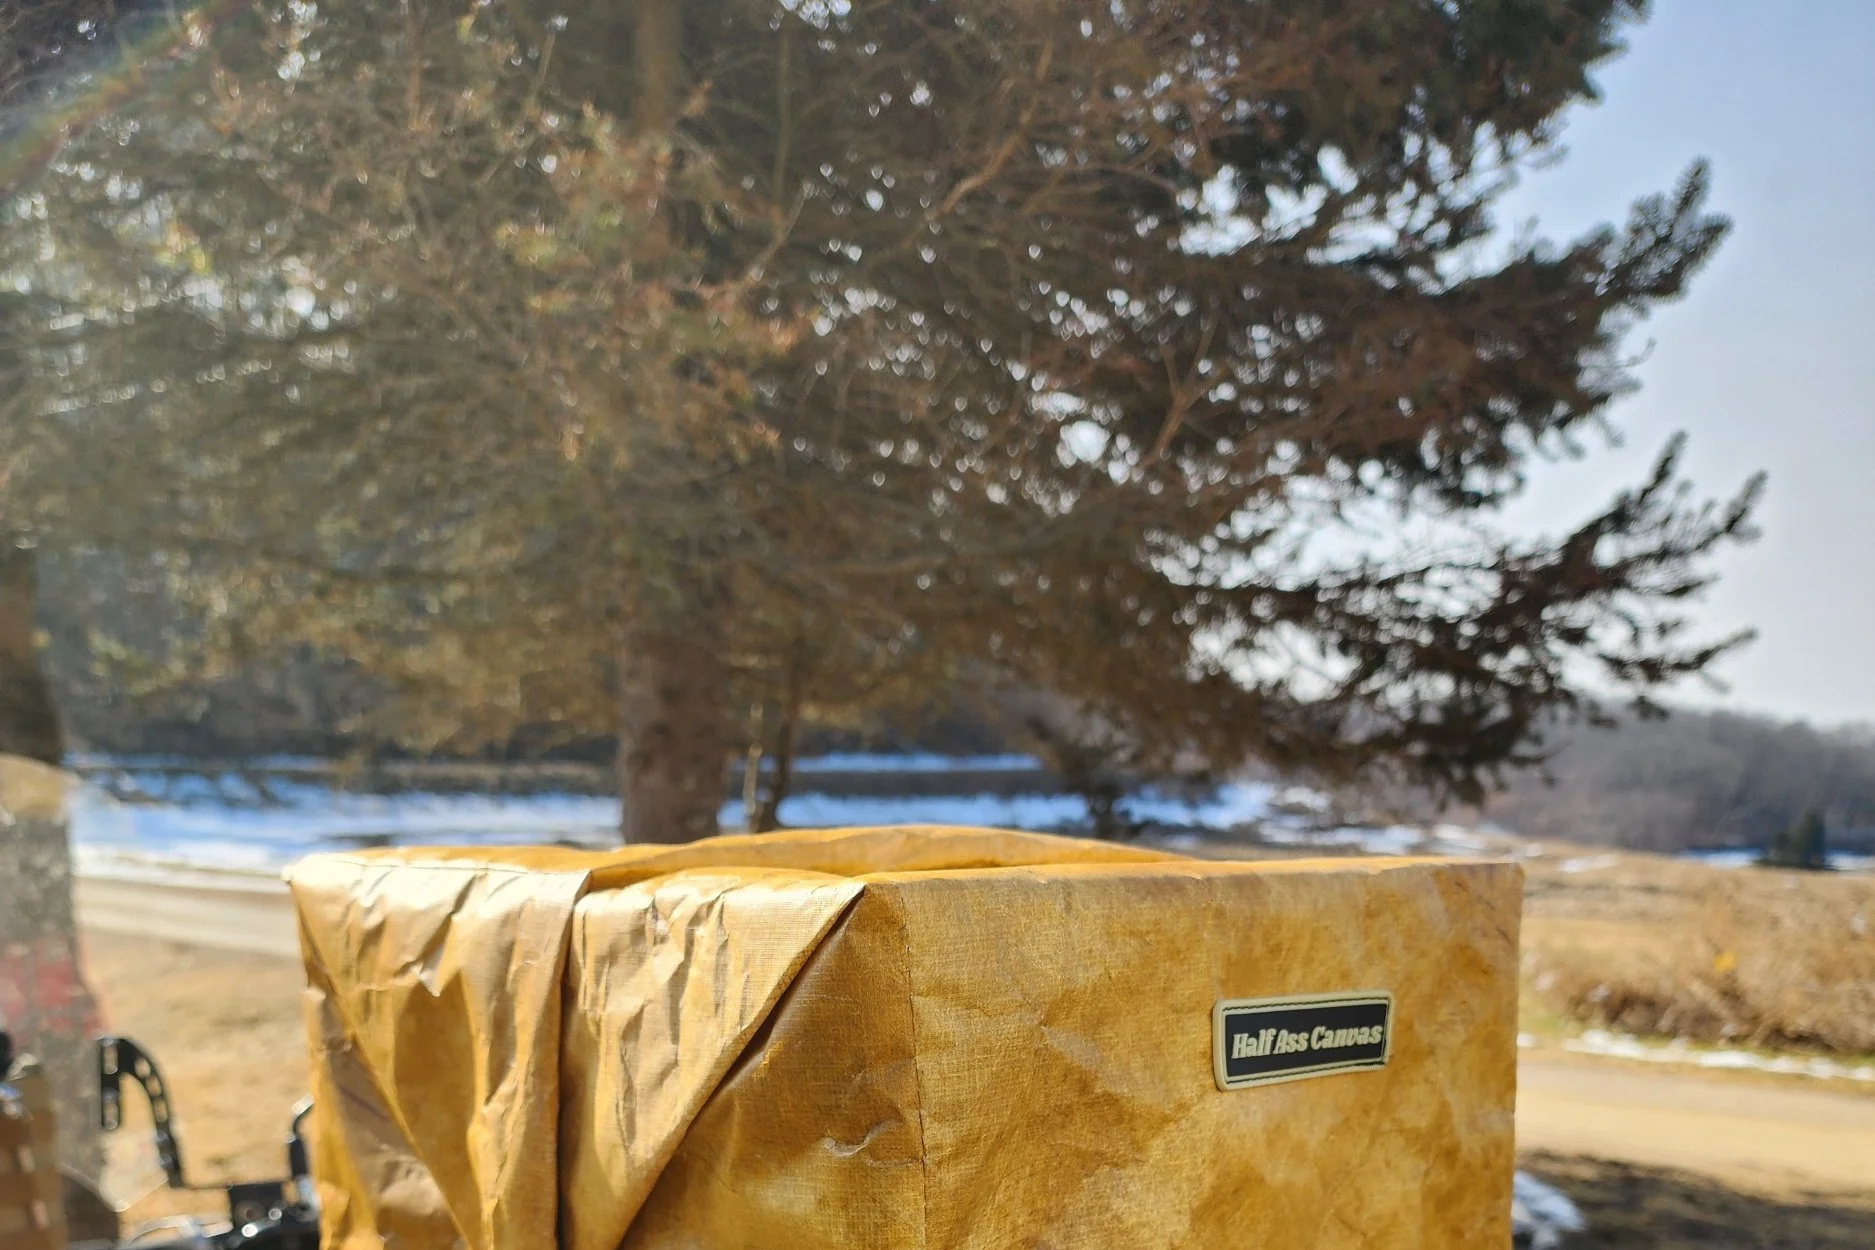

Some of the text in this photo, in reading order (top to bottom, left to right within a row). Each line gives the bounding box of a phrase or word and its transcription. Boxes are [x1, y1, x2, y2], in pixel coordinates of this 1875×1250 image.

[1231, 1025, 1383, 1059] Half Ass Canvas
